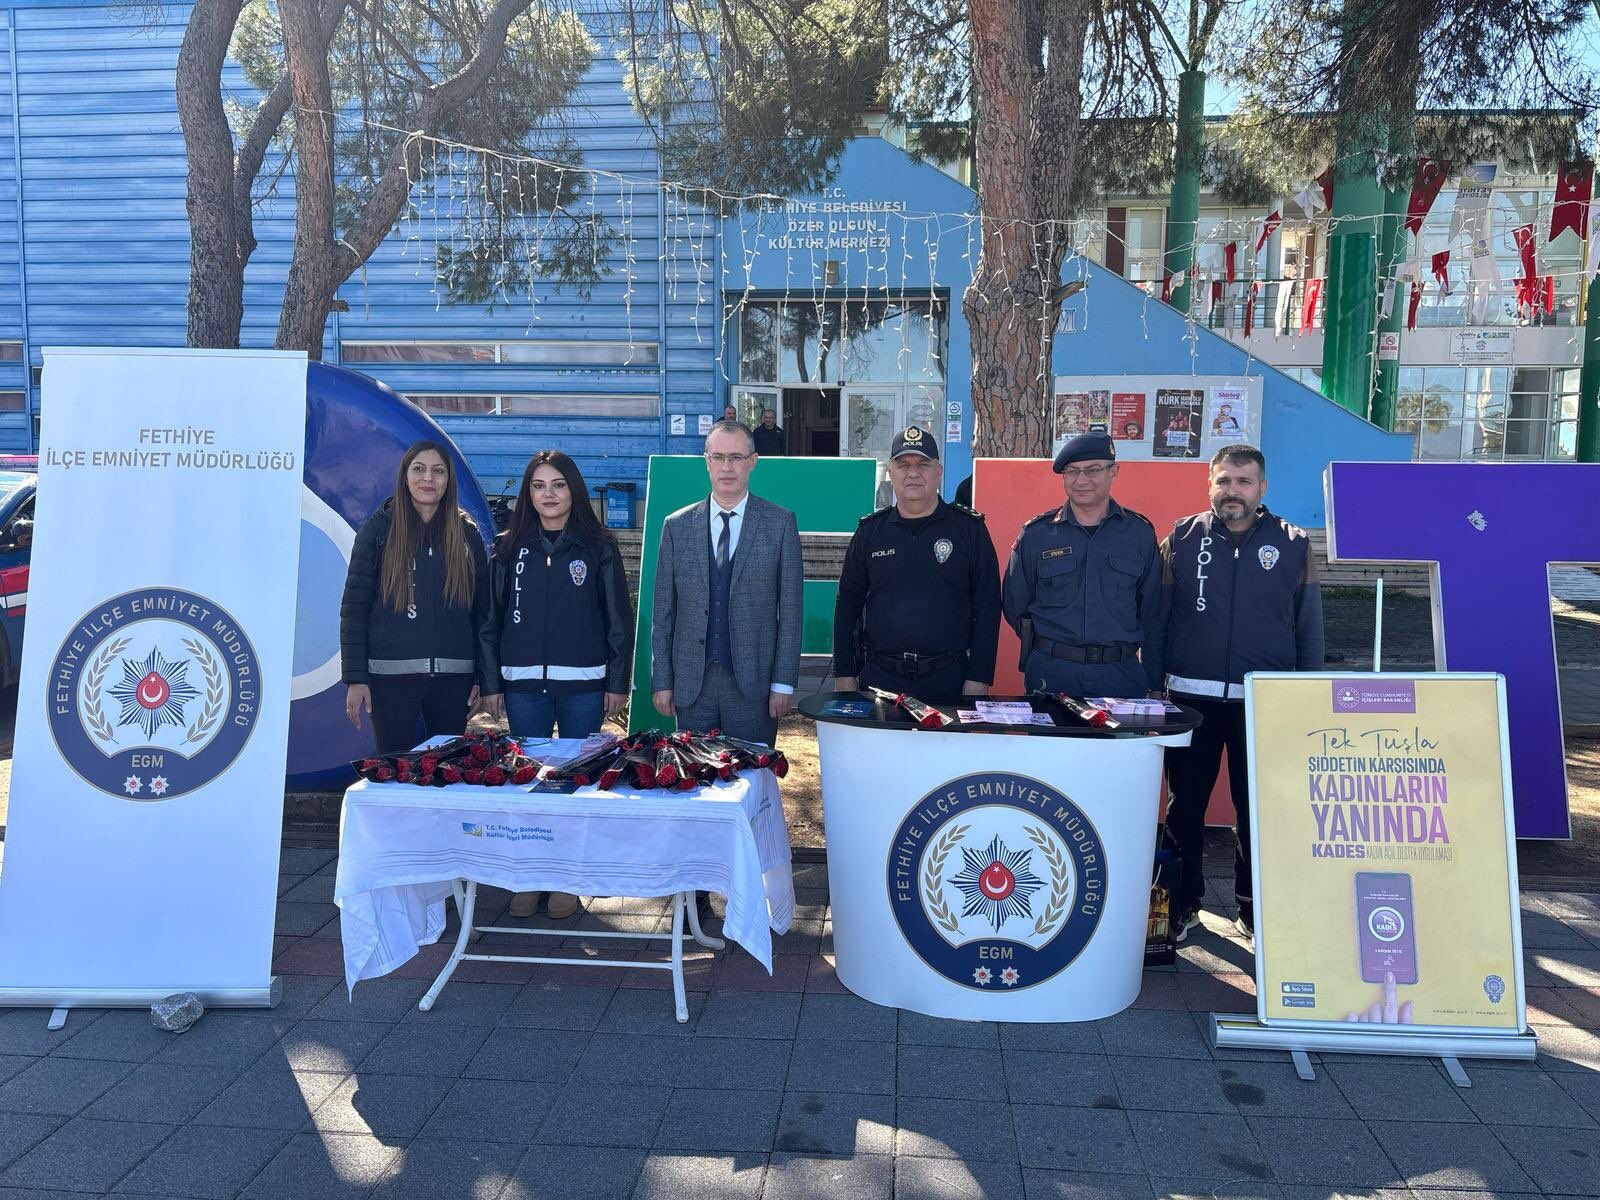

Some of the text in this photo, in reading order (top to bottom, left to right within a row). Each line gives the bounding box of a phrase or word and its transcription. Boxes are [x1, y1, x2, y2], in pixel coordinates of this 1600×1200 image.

[788, 218, 877, 232] ÖZER OLGUN
[768, 234, 891, 249] KÜLTÜR MERKEZİ
[1158, 393, 1179, 406] KÜRK
[139, 426, 215, 445] FETHİYE
[46, 447, 295, 471] İLÇE EMNİYET MÜDÜRLÜĞÜ
[56, 595, 254, 727] FETHİYE İLÇE EMNİYET MÜDÜRLÜĞÜ
[1307, 726, 1440, 757] Tek Tuşla
[131, 754, 164, 769] EGM
[1369, 757, 1446, 774] KARŞISINDA
[1309, 774, 1448, 804] KADINLARIN
[1311, 804, 1450, 844] YANINDA
[896, 780, 1102, 916] FETHİYE İLÇE EMNİYET MÜDÜRLÜĞÜ
[1312, 843, 1366, 859] KADES
[979, 946, 1013, 960] EGM
